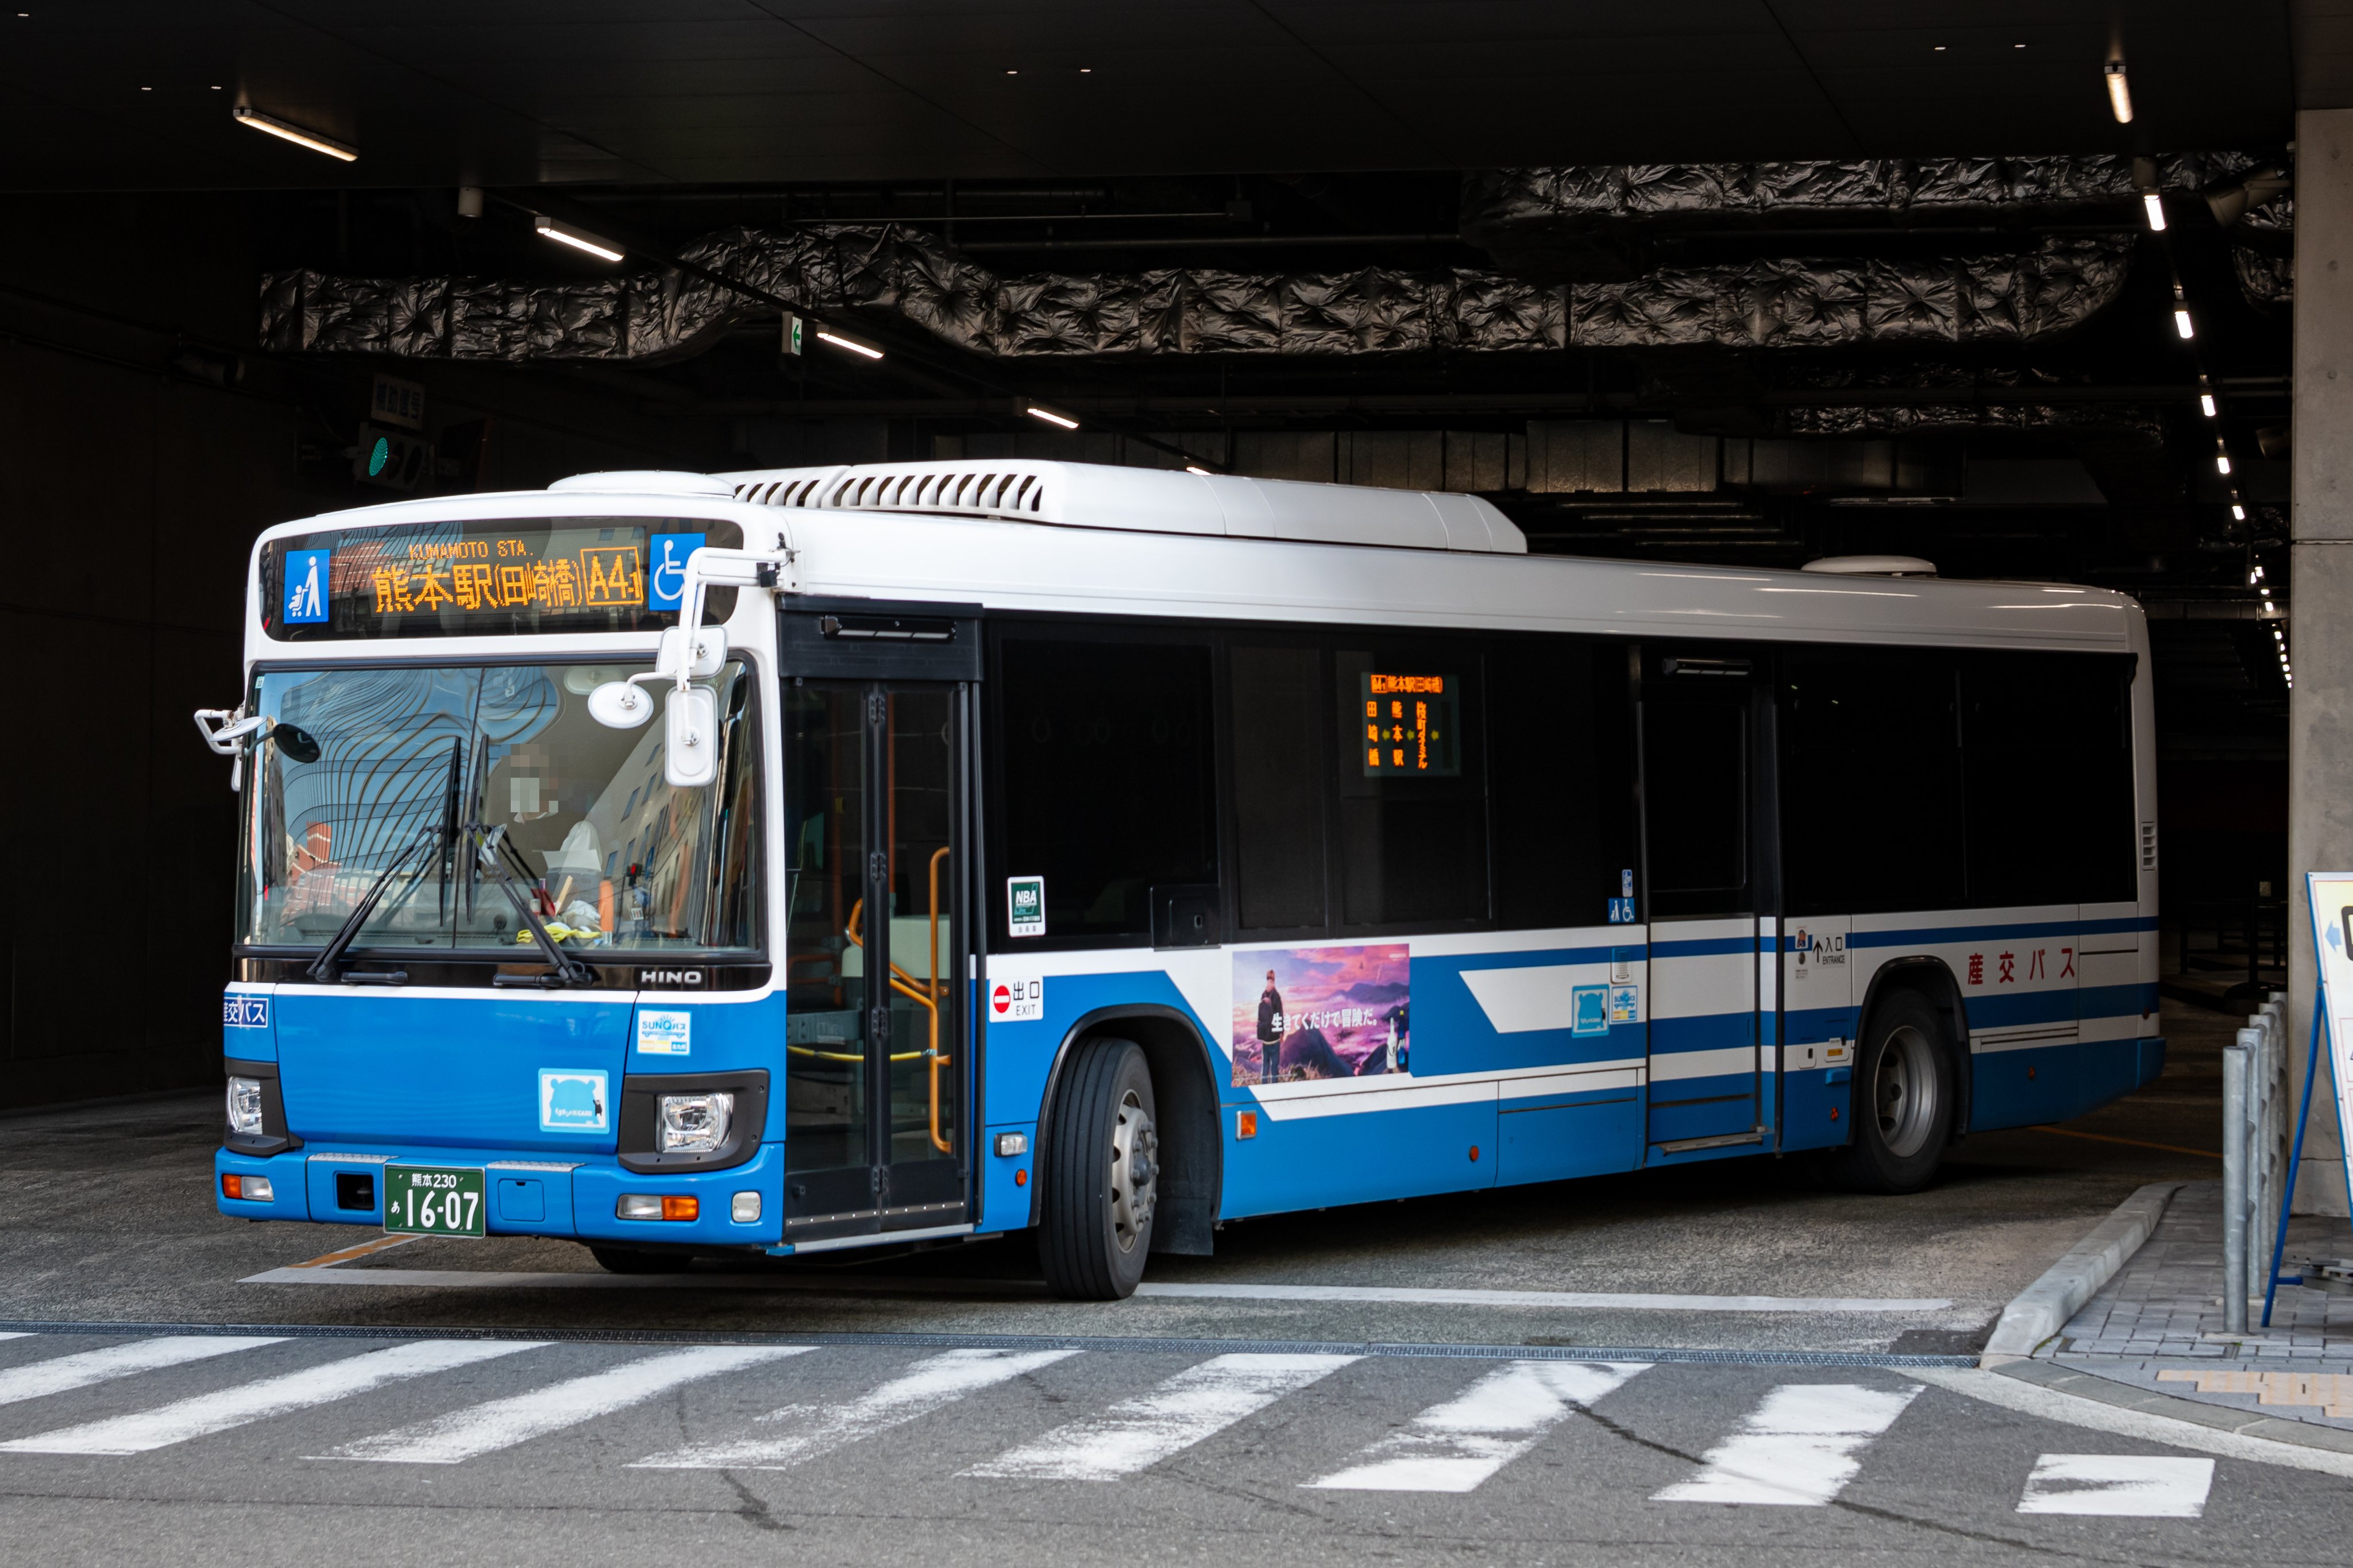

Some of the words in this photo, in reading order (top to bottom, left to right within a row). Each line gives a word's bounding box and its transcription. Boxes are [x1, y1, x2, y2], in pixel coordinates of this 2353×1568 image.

[410, 541, 488, 560] KUMAMOTO
[498, 540, 534, 558] STA.
[371, 559, 581, 613] 熊本駅(田崎橋)
[1016, 890, 1037, 904] NBA
[1825, 936, 1842, 952] 入口
[1822, 955, 1845, 965] ENTRANCE
[1968, 948, 2075, 984] 産交バス
[642, 971, 701, 984] HINO
[1013, 981, 1039, 1001] 出口
[1016, 1004, 1036, 1016] EXIT
[1271, 1008, 1377, 1032] 生きてくだけで冒険だ。
[412, 1173, 457, 1188] 熊本230
[391, 1200, 400, 1214] あ
[407, 1189, 479, 1231] 16-07
